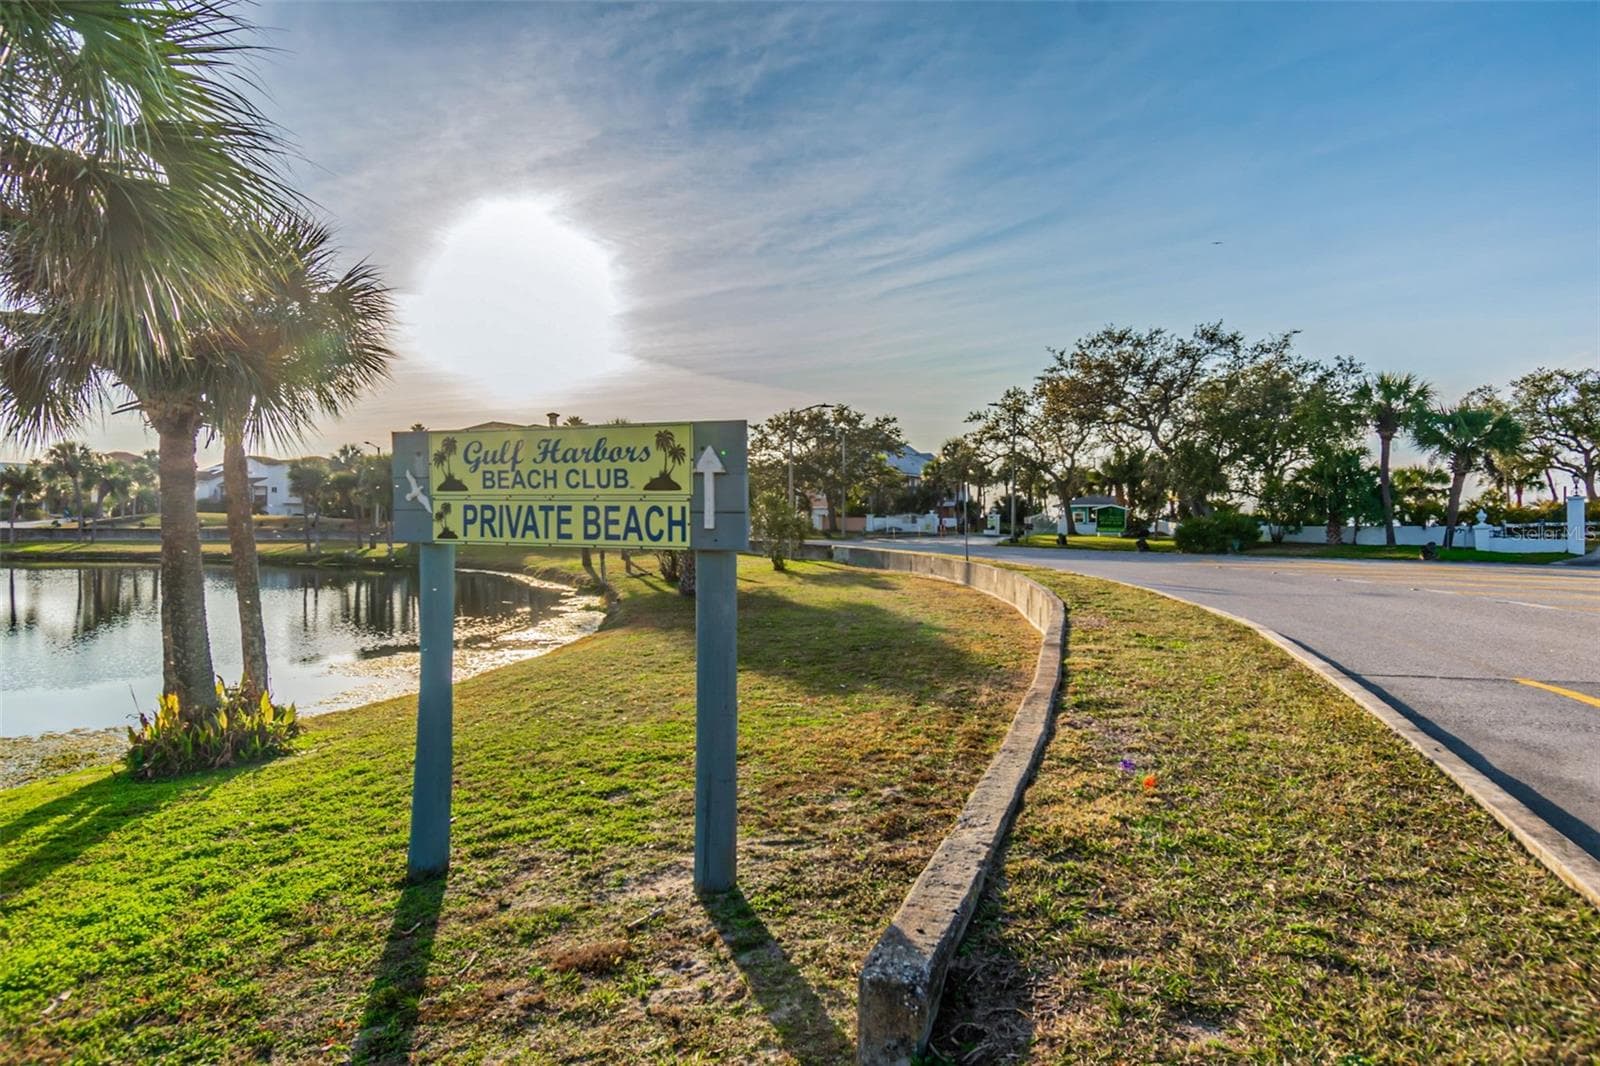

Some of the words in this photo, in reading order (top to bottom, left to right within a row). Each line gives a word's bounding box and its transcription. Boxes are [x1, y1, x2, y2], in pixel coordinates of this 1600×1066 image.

[463, 440, 524, 473] Gulf
[533, 437, 651, 465] Harbors
[482, 469, 557, 490] BEACH
[565, 468, 629, 489] CLUB
[462, 504, 573, 540] PRIVATE
[583, 506, 687, 542] BEACH
